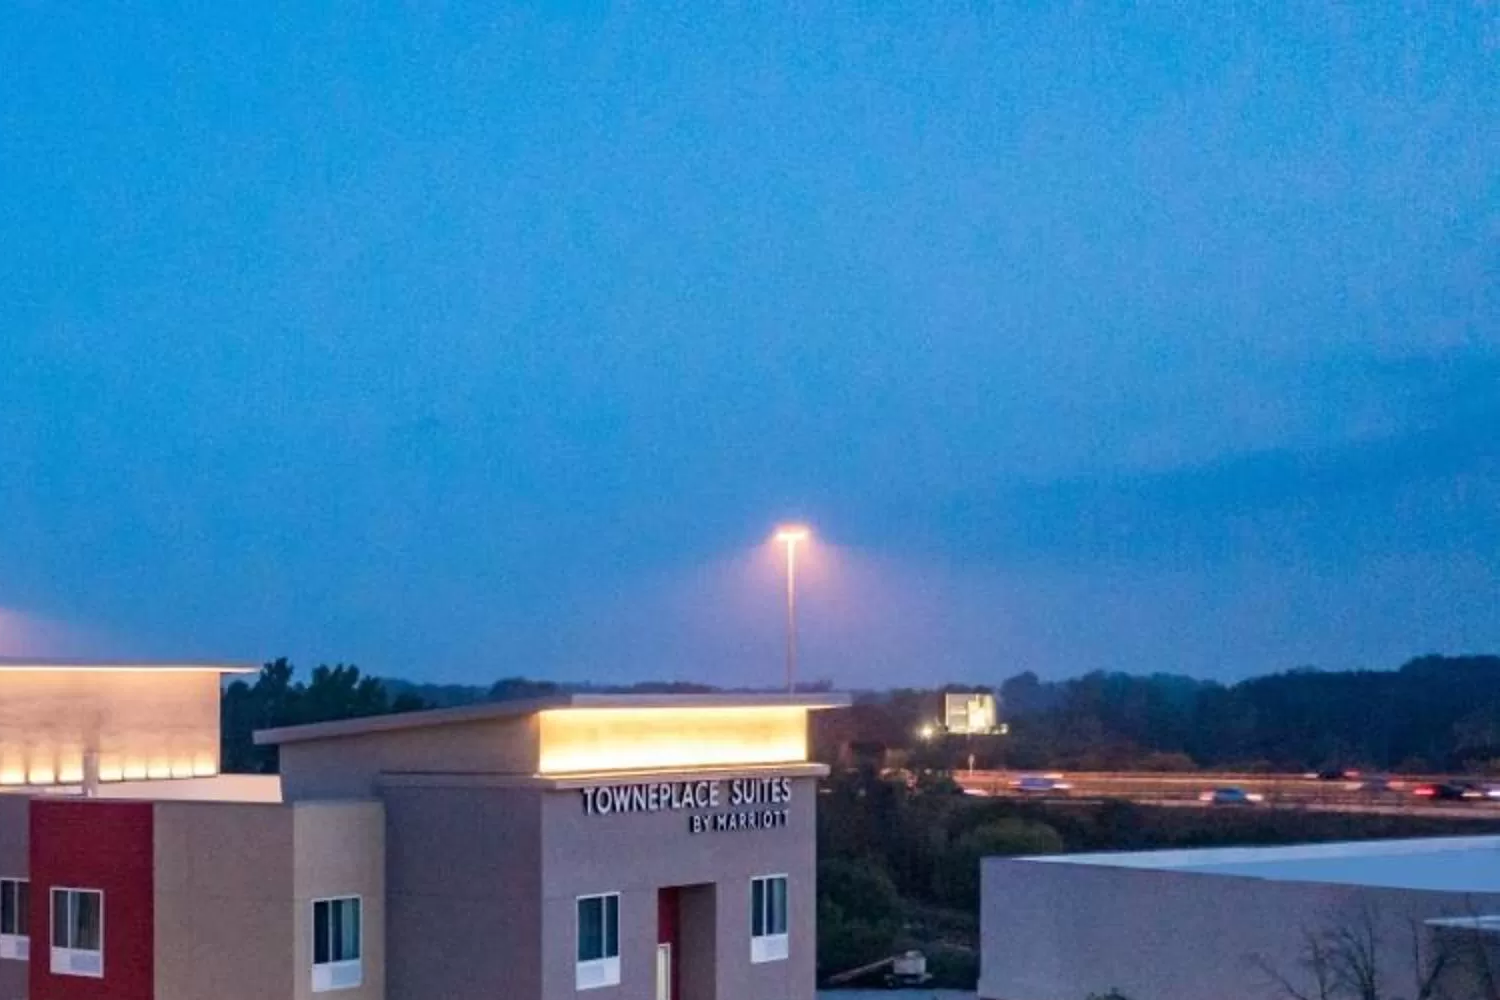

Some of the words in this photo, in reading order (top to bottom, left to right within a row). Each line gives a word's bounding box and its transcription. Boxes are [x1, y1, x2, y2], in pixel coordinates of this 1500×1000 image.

[583, 781, 719, 815] TOWNEPLACE
[731, 778, 792, 805] SUITES
[692, 814, 711, 833] BY
[716, 810, 789, 832] MARRIOTT
